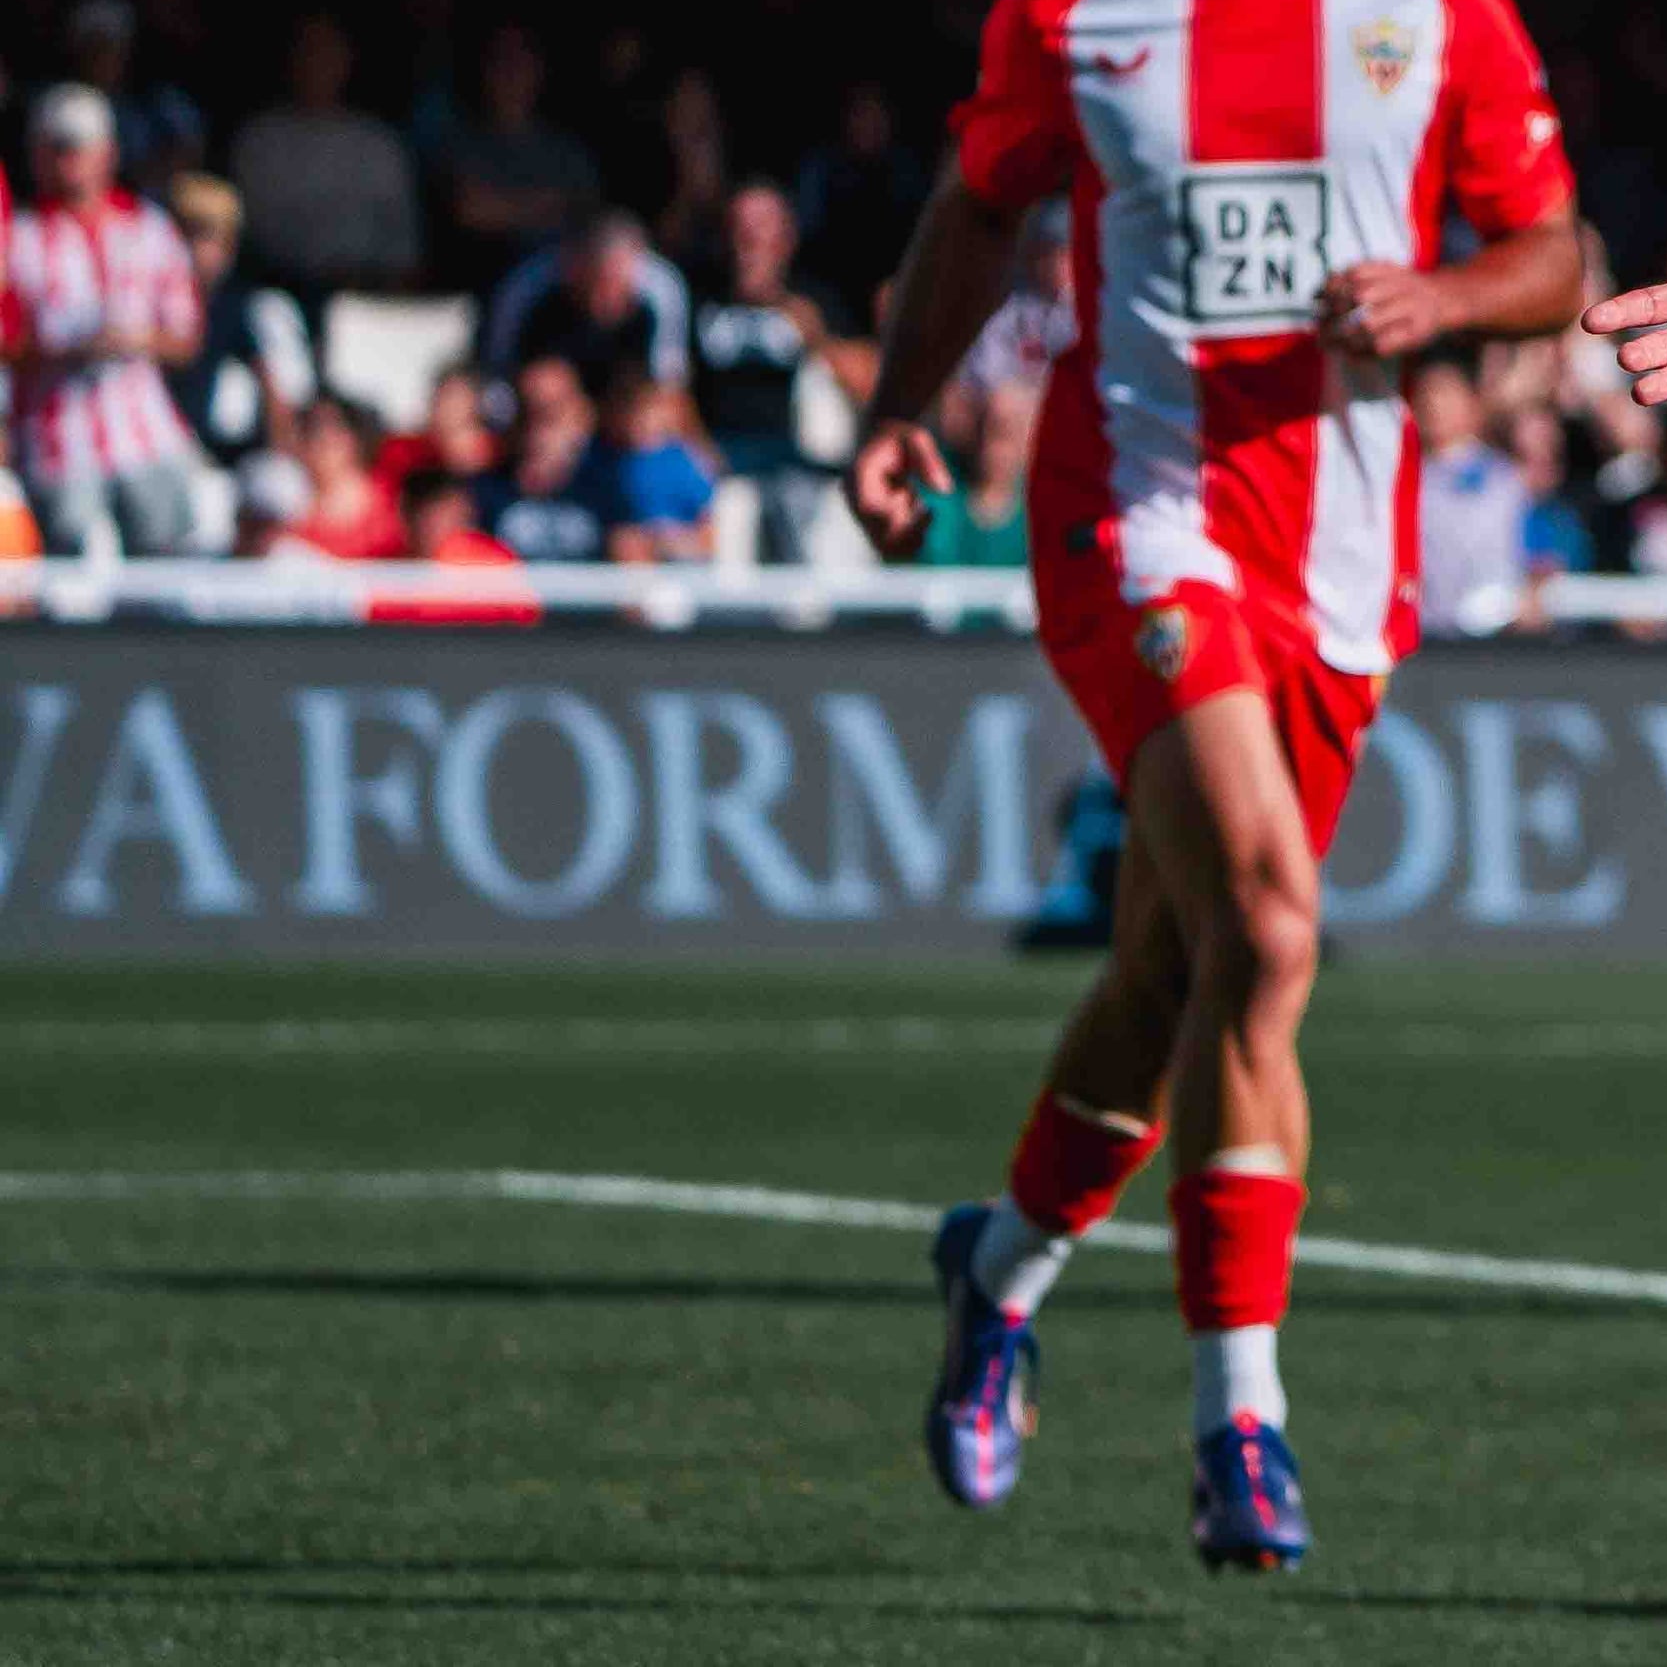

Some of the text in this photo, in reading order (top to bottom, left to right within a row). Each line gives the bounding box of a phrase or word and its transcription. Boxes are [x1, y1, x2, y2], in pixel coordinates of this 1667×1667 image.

[1218, 200, 1294, 239] DA
[1217, 256, 1295, 299] ZN
[290, 686, 1046, 922] FORM
